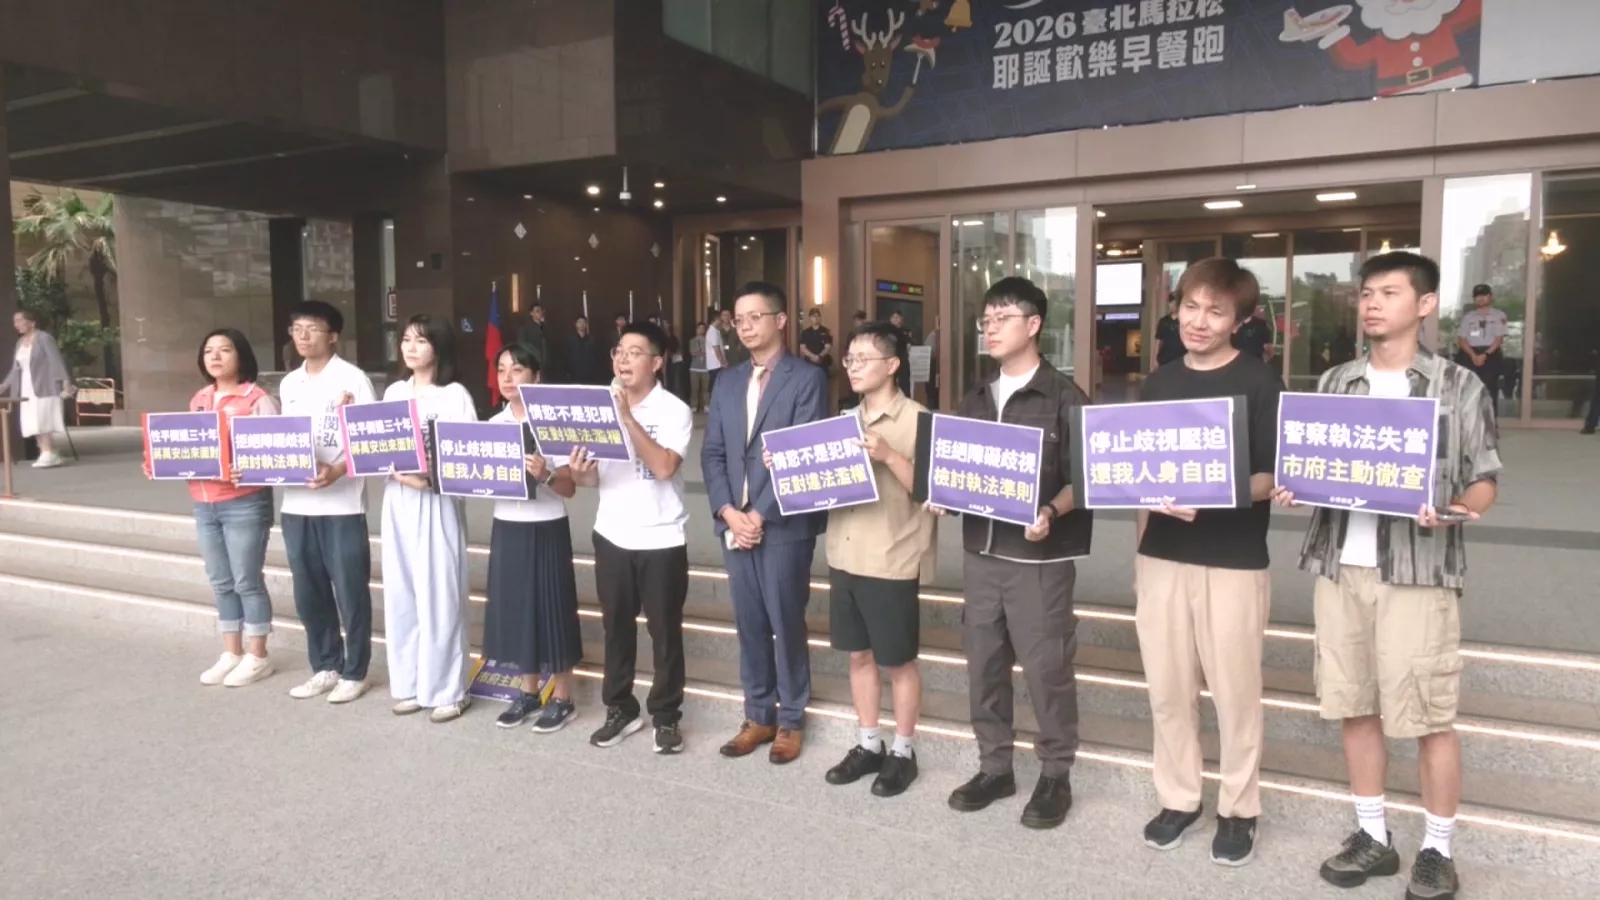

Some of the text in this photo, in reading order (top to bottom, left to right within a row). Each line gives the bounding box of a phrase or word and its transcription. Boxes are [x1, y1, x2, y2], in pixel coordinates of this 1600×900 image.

[994, 0, 1224, 48] 2026 臺北馬拉松
[992, 25, 1225, 90] 耶誕歡樂早餐跑
[529, 403, 615, 424] 情慾不是犯罪
[440, 439, 522, 460] 停止歧視壓迫
[1088, 425, 1228, 455] 停止歧視壓迫
[1283, 420, 1429, 455] 警察執法失當
[935, 437, 1037, 474] 拒絕障礙歧視
[441, 462, 522, 483] 還我人身自由
[933, 466, 1034, 504] 檢討執法準則
[1089, 459, 1228, 486] 還我人身自由
